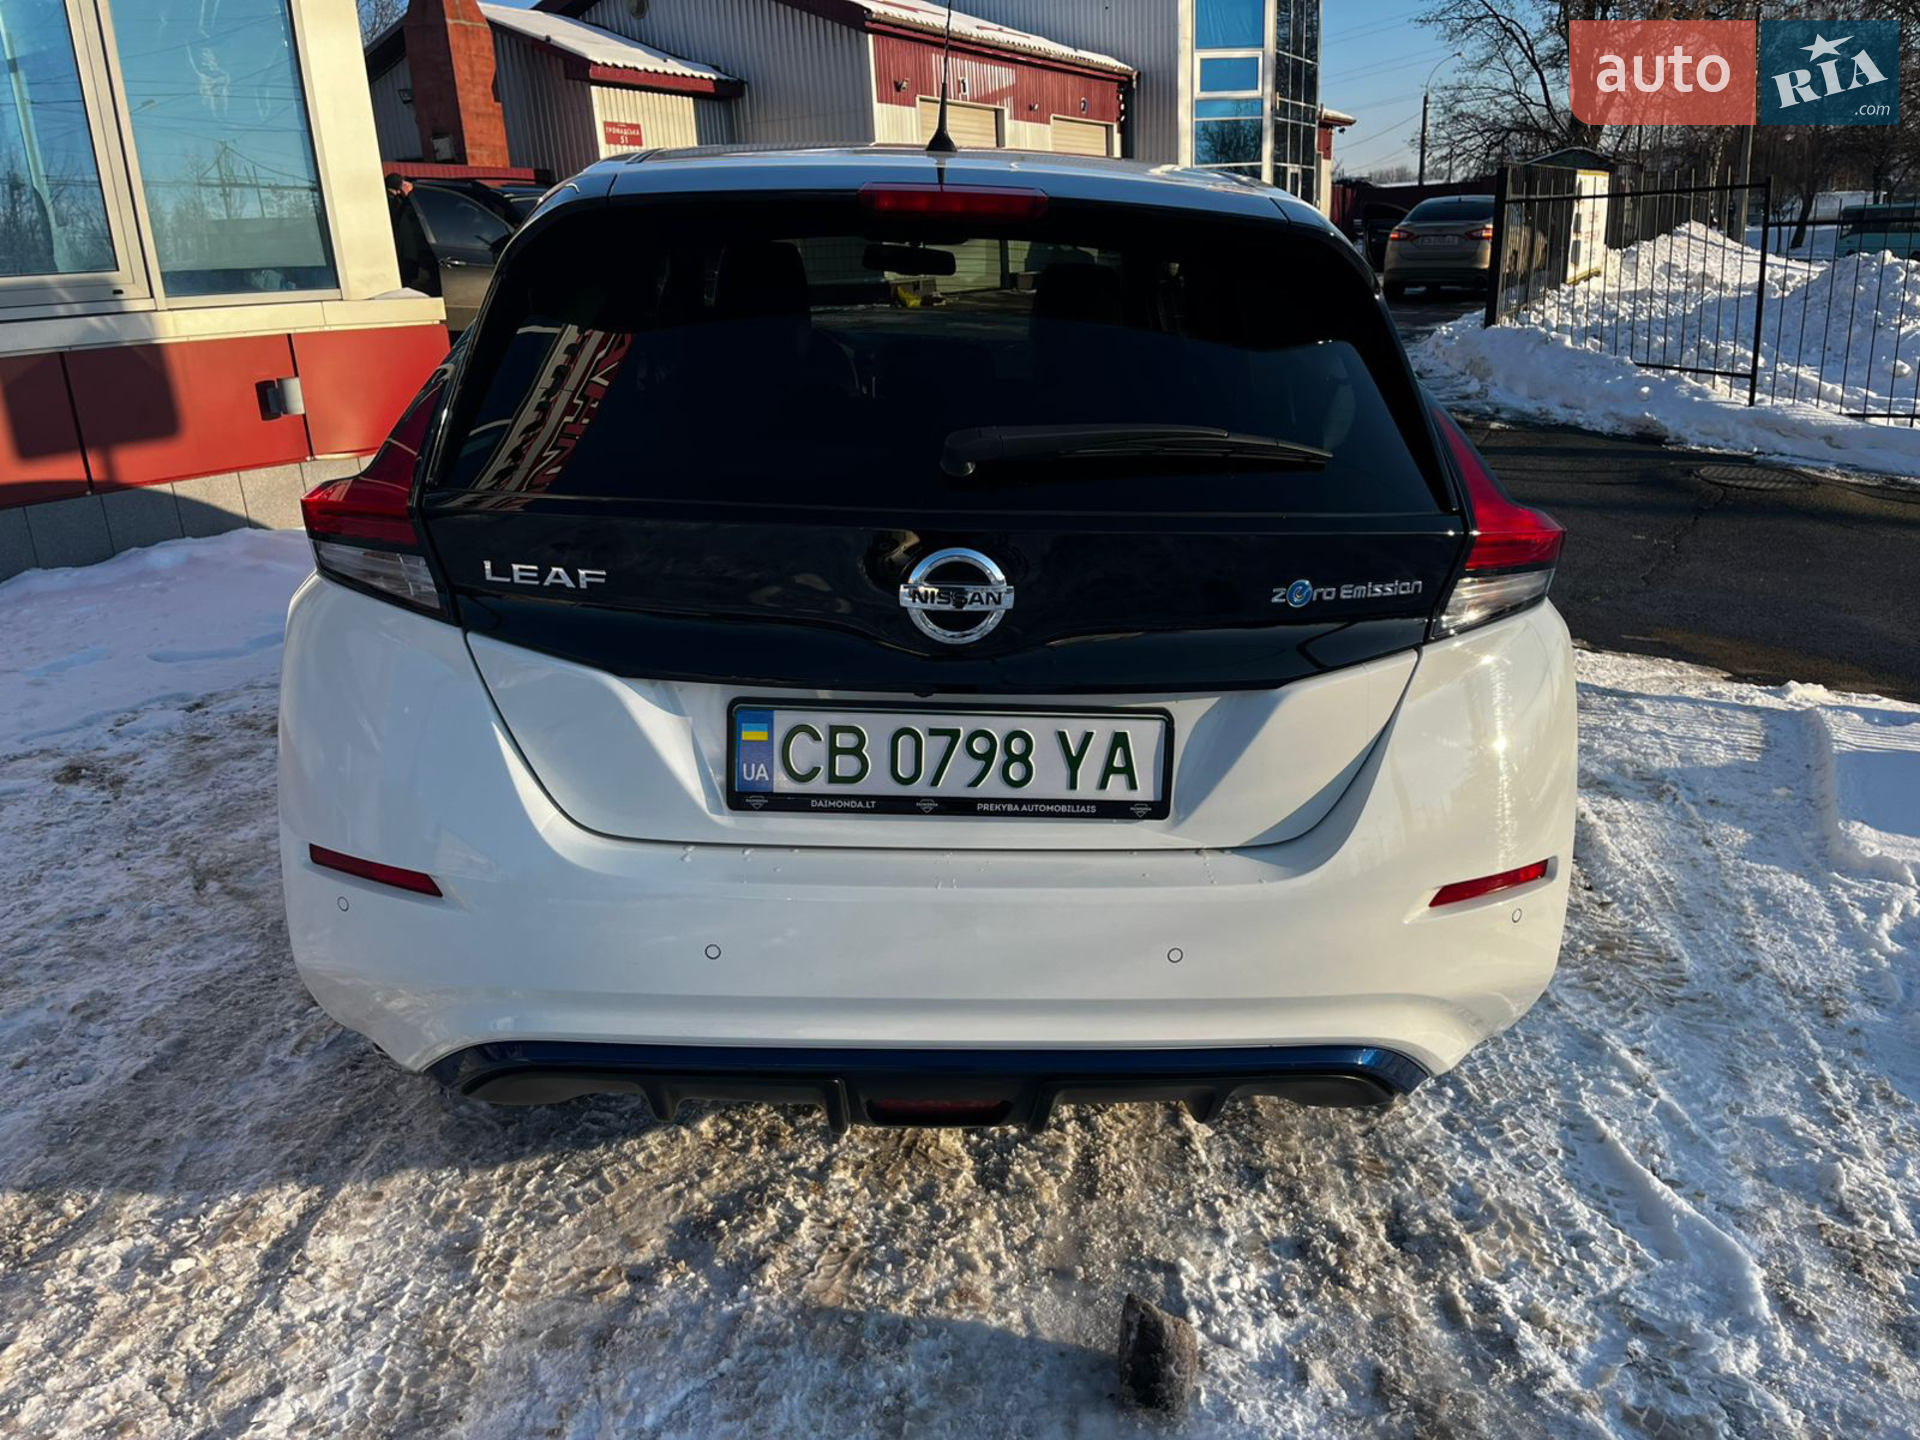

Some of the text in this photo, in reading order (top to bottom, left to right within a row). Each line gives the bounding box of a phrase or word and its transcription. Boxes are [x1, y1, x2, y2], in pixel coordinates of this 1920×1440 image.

[620, 135, 629, 144] 51
[483, 560, 607, 590] LEAF
[911, 589, 1003, 606] NISSAN
[1339, 580, 1423, 600] Emission
[781, 723, 1139, 792] CB 0798 YA
[742, 764, 770, 783] UA
[810, 799, 1097, 814] DAIMONDA.LT PREKYBA AUTOMOBILIAIS
